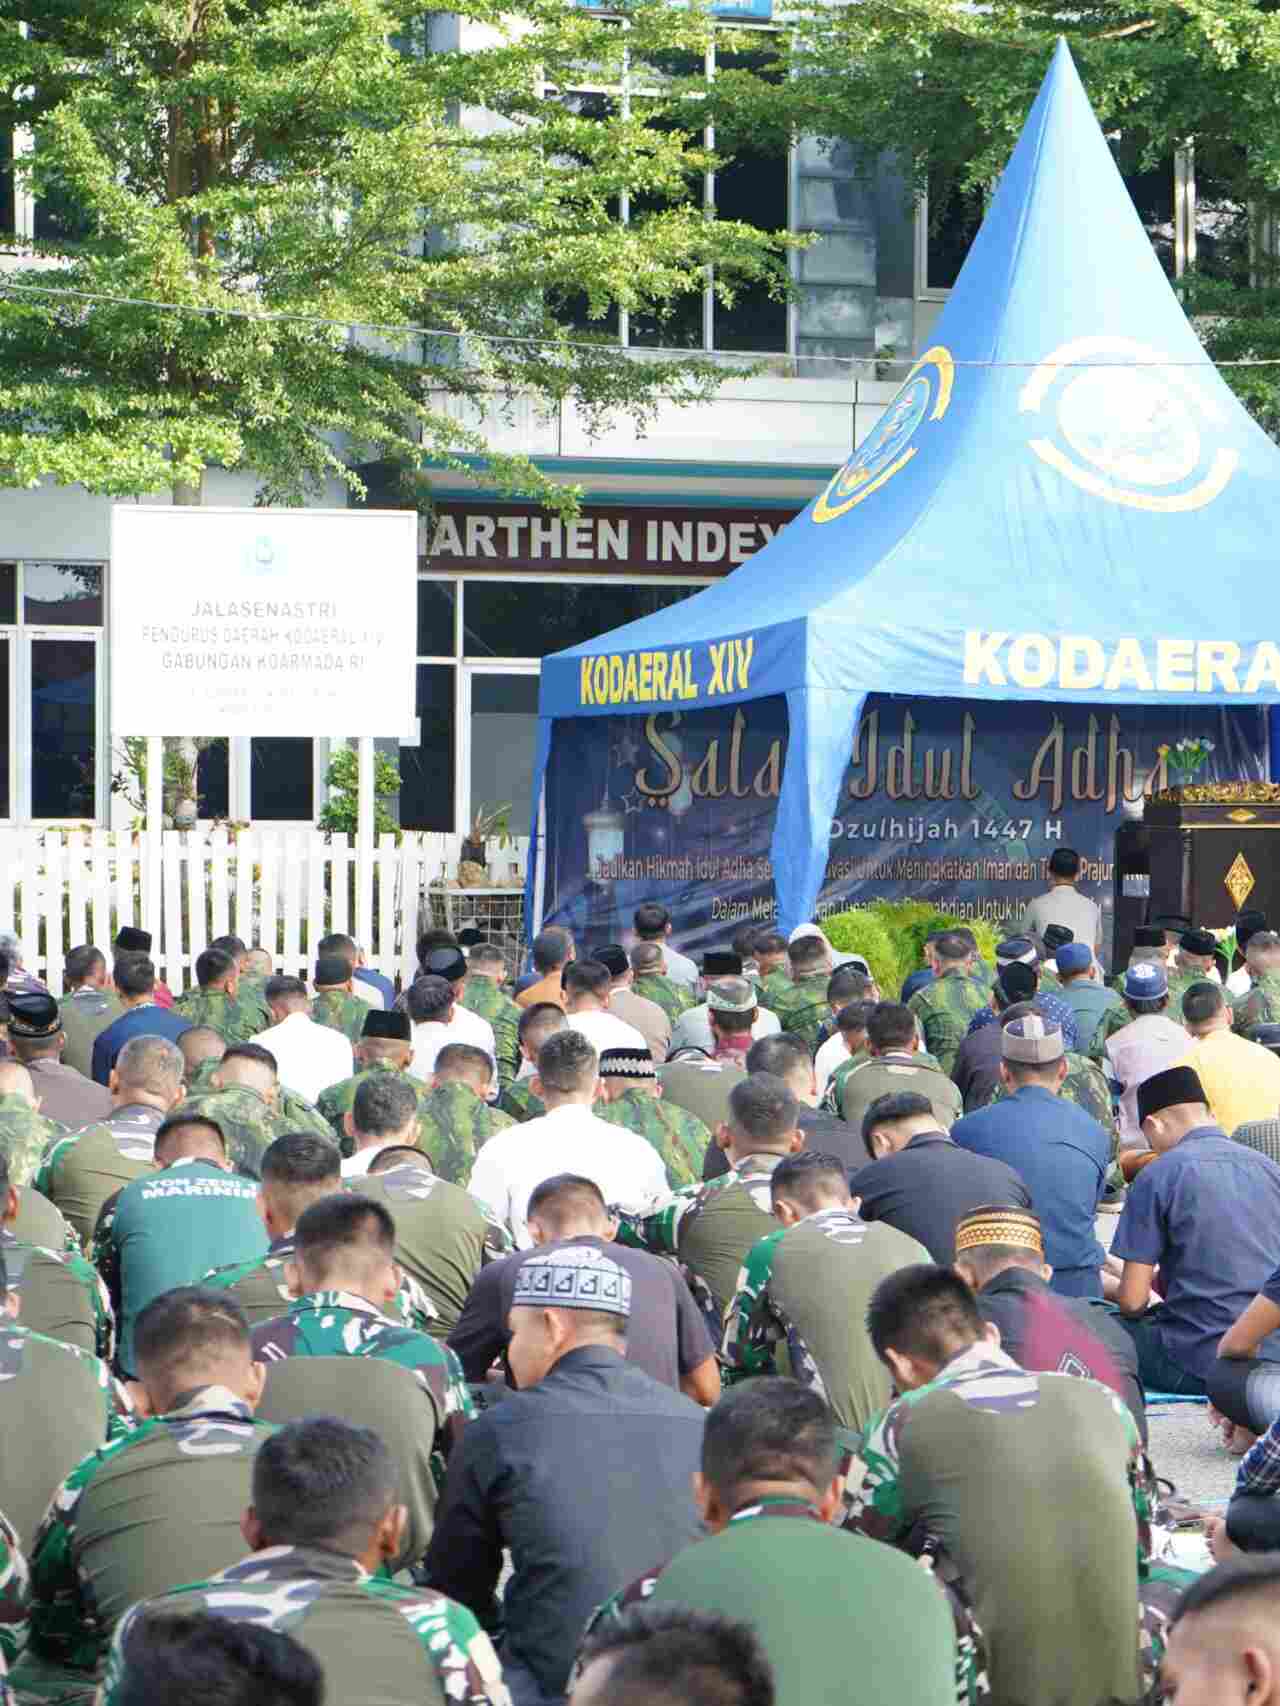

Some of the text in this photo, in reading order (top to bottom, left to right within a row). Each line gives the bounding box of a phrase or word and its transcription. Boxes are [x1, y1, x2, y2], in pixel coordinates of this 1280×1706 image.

[191, 600, 337, 618] JALASENASTRI
[161, 653, 251, 672] GABUNGAN
[257, 654, 345, 672] KOARMADA
[580, 637, 754, 705] KODAERAL XIV
[634, 707, 781, 798] Sala
[849, 708, 982, 800] Idul
[830, 817, 1063, 843] Dzulhijah 1447 H
[646, 856, 694, 881] Hikmah
[897, 856, 979, 881] Meningkatkan
[983, 857, 1012, 881] Iman
[711, 896, 750, 922] Dalam
[977, 896, 1013, 921] Untuk
